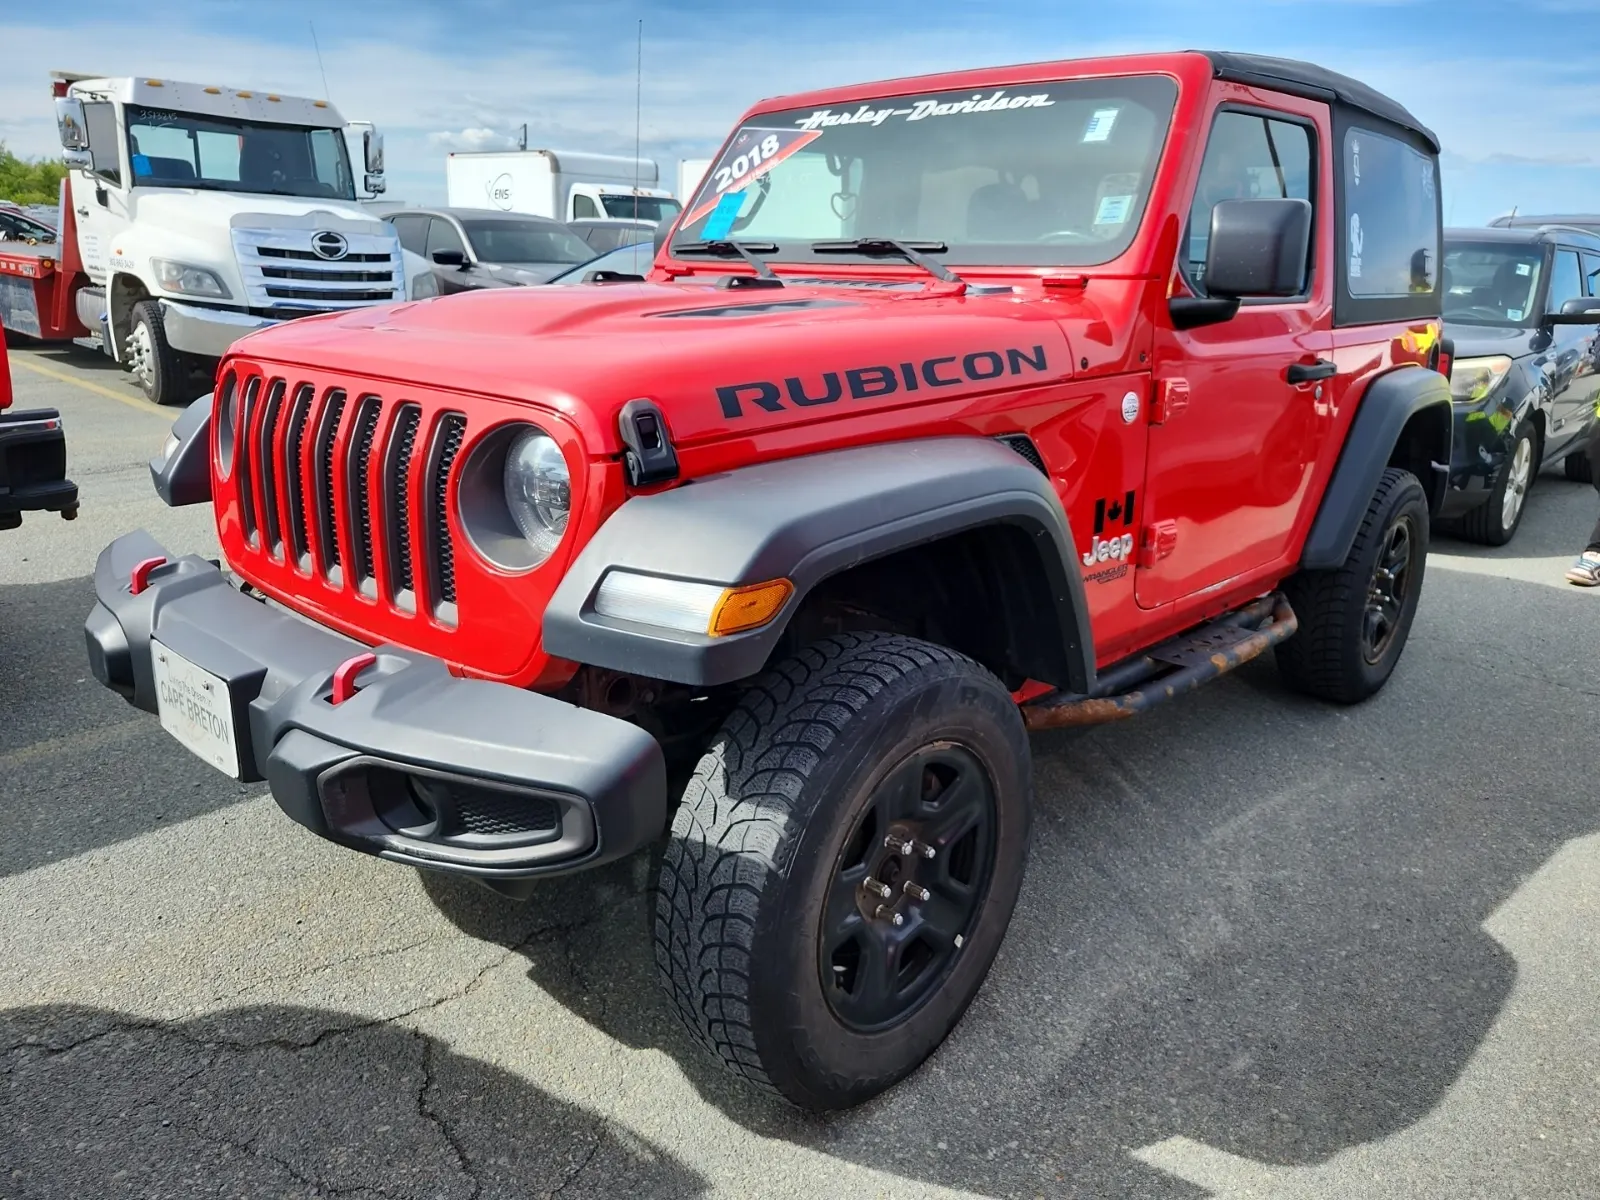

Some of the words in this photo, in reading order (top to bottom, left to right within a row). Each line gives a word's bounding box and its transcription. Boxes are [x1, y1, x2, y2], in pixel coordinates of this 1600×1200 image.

[794, 90, 1056, 130] Harley-Davidson
[714, 134, 780, 194] 2018
[494, 188, 510, 200] ENS
[715, 345, 1048, 419] RUBICON
[1082, 532, 1131, 566] Jeep
[1082, 564, 1128, 582] WRANGLER
[160, 680, 187, 716] CAPE
[187, 698, 230, 745] BRETON
